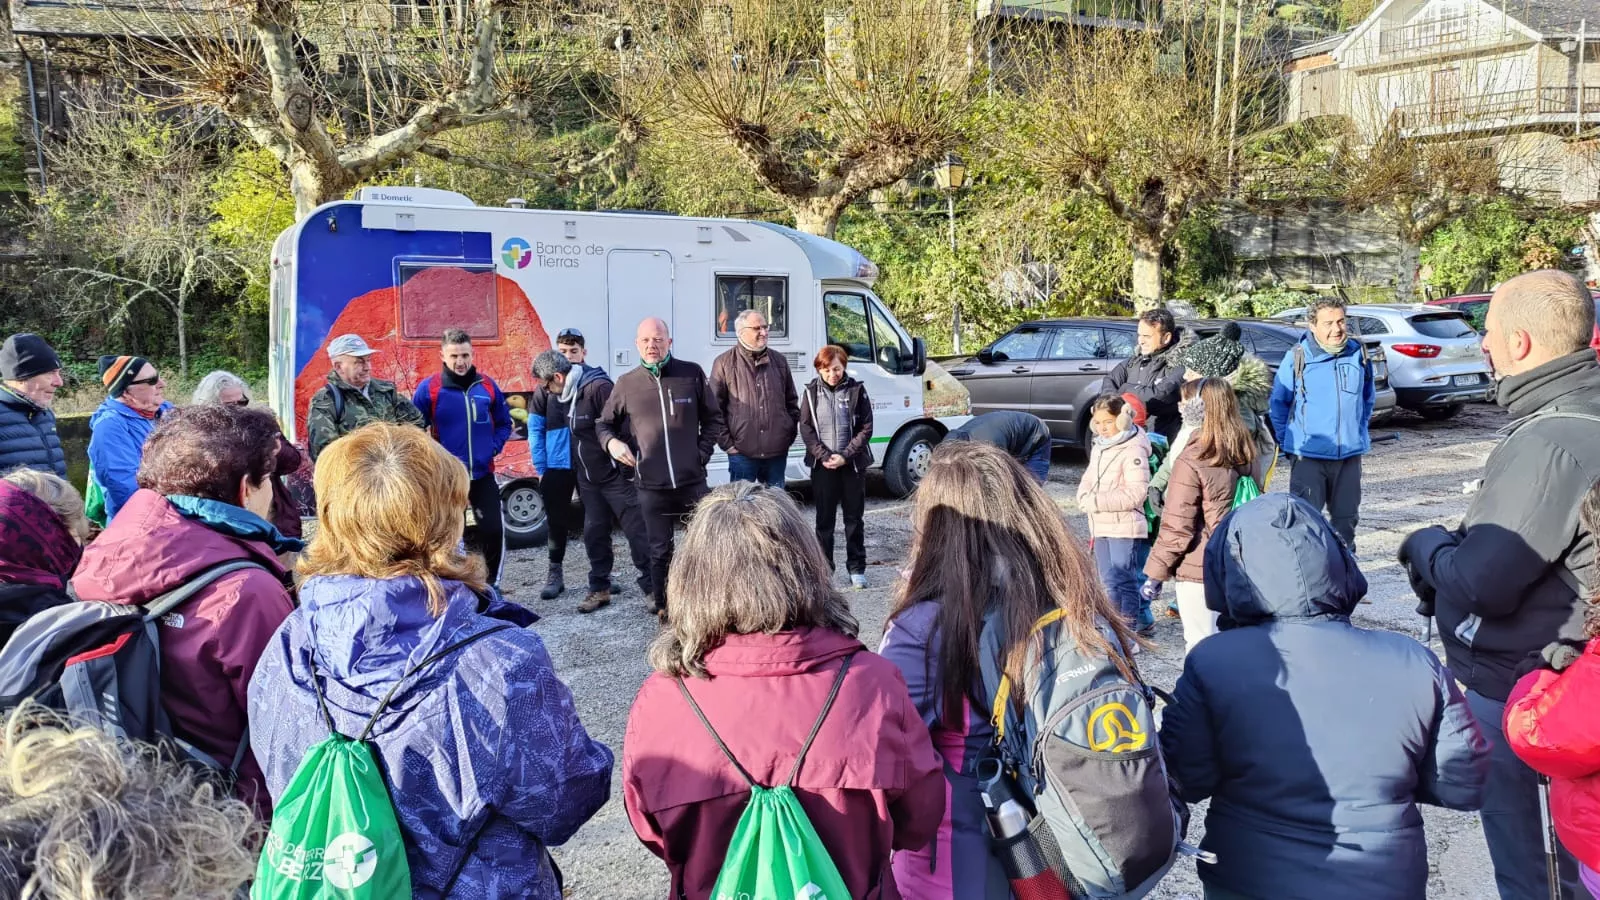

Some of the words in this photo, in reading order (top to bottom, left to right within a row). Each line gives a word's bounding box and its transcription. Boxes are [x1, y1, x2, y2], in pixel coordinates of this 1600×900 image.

[380, 193, 413, 202] Dometic
[536, 241, 581, 255] Banco
[585, 243, 604, 255] de
[536, 254, 580, 268] Tierras
